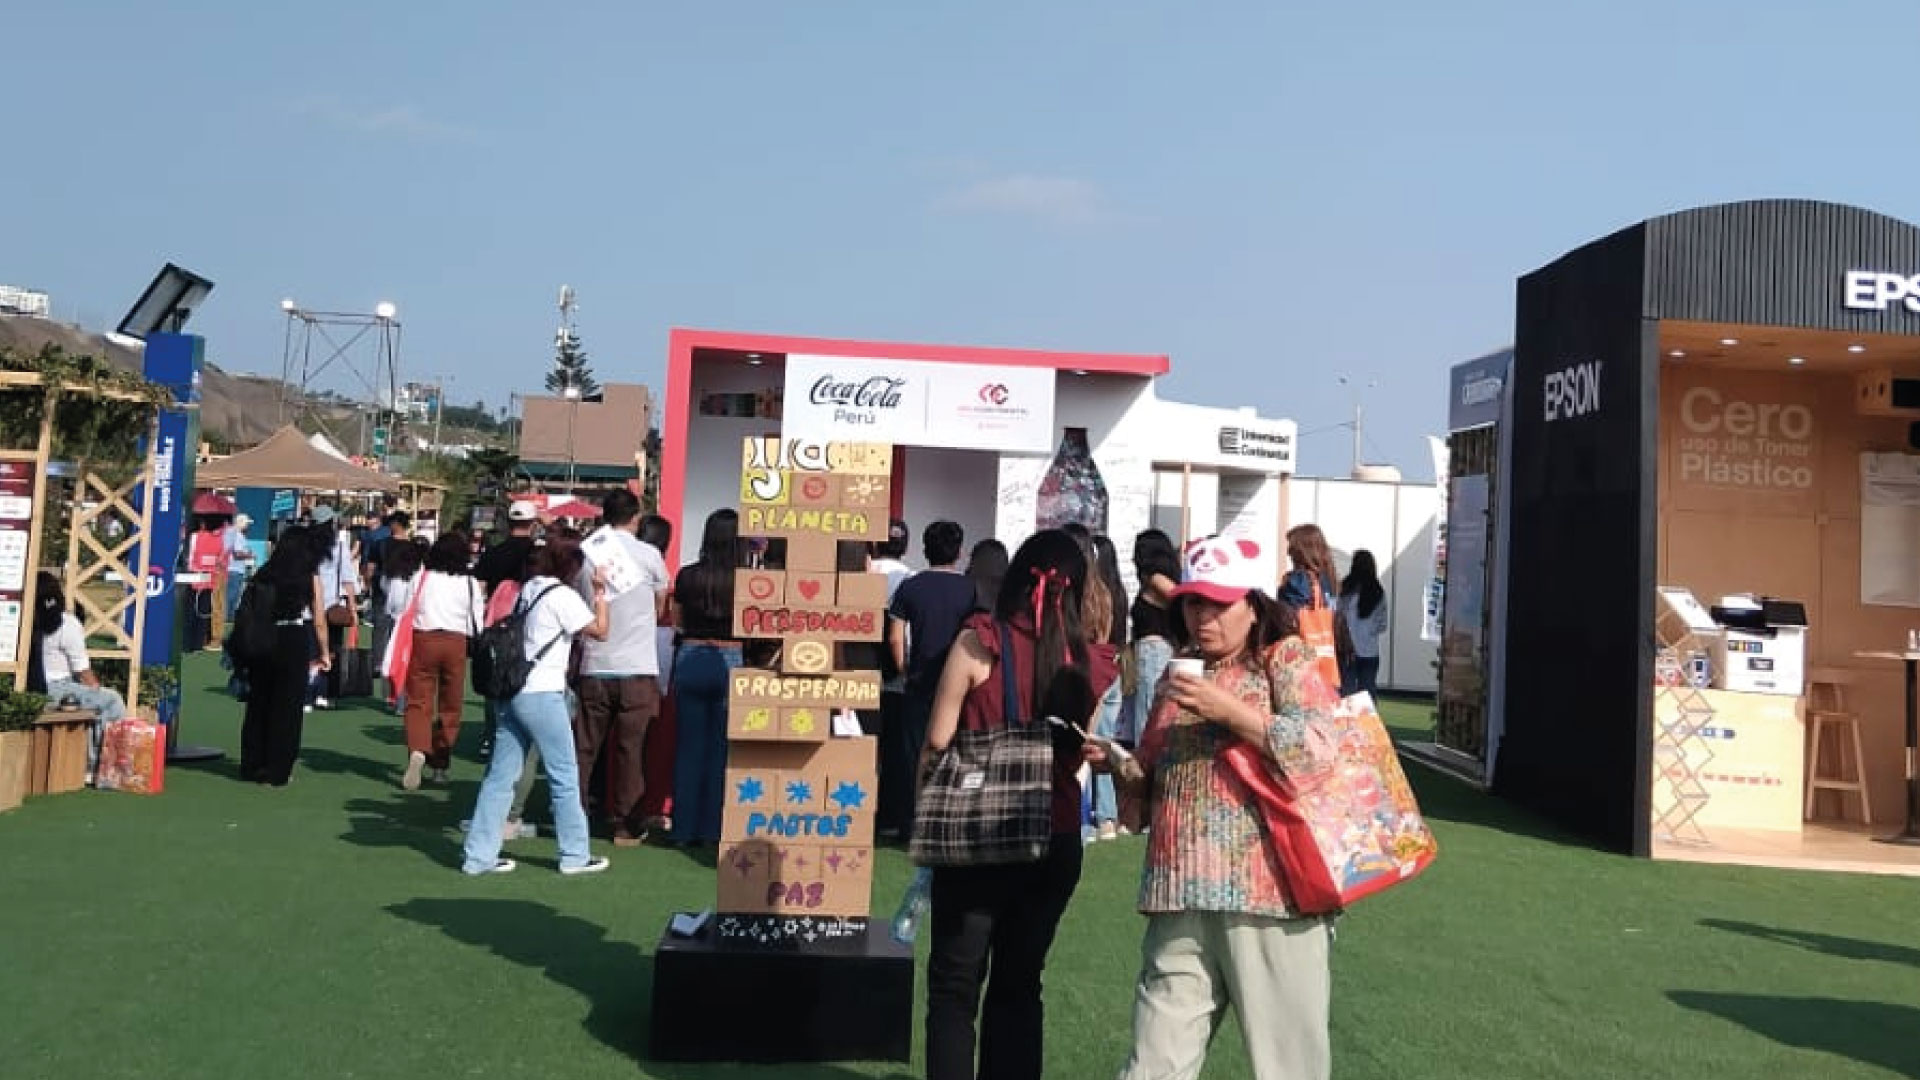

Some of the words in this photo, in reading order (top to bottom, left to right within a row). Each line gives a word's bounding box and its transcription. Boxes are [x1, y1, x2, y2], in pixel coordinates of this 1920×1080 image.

[1544, 361, 1601, 422] EPSON
[833, 408, 876, 425] Perú
[1681, 386, 1813, 439] Cero
[1681, 453, 1813, 488] Plástico
[749, 508, 868, 534] PLANETA
[743, 605, 875, 634] PERSONAS
[735, 678, 878, 701] PROSPERIDAD
